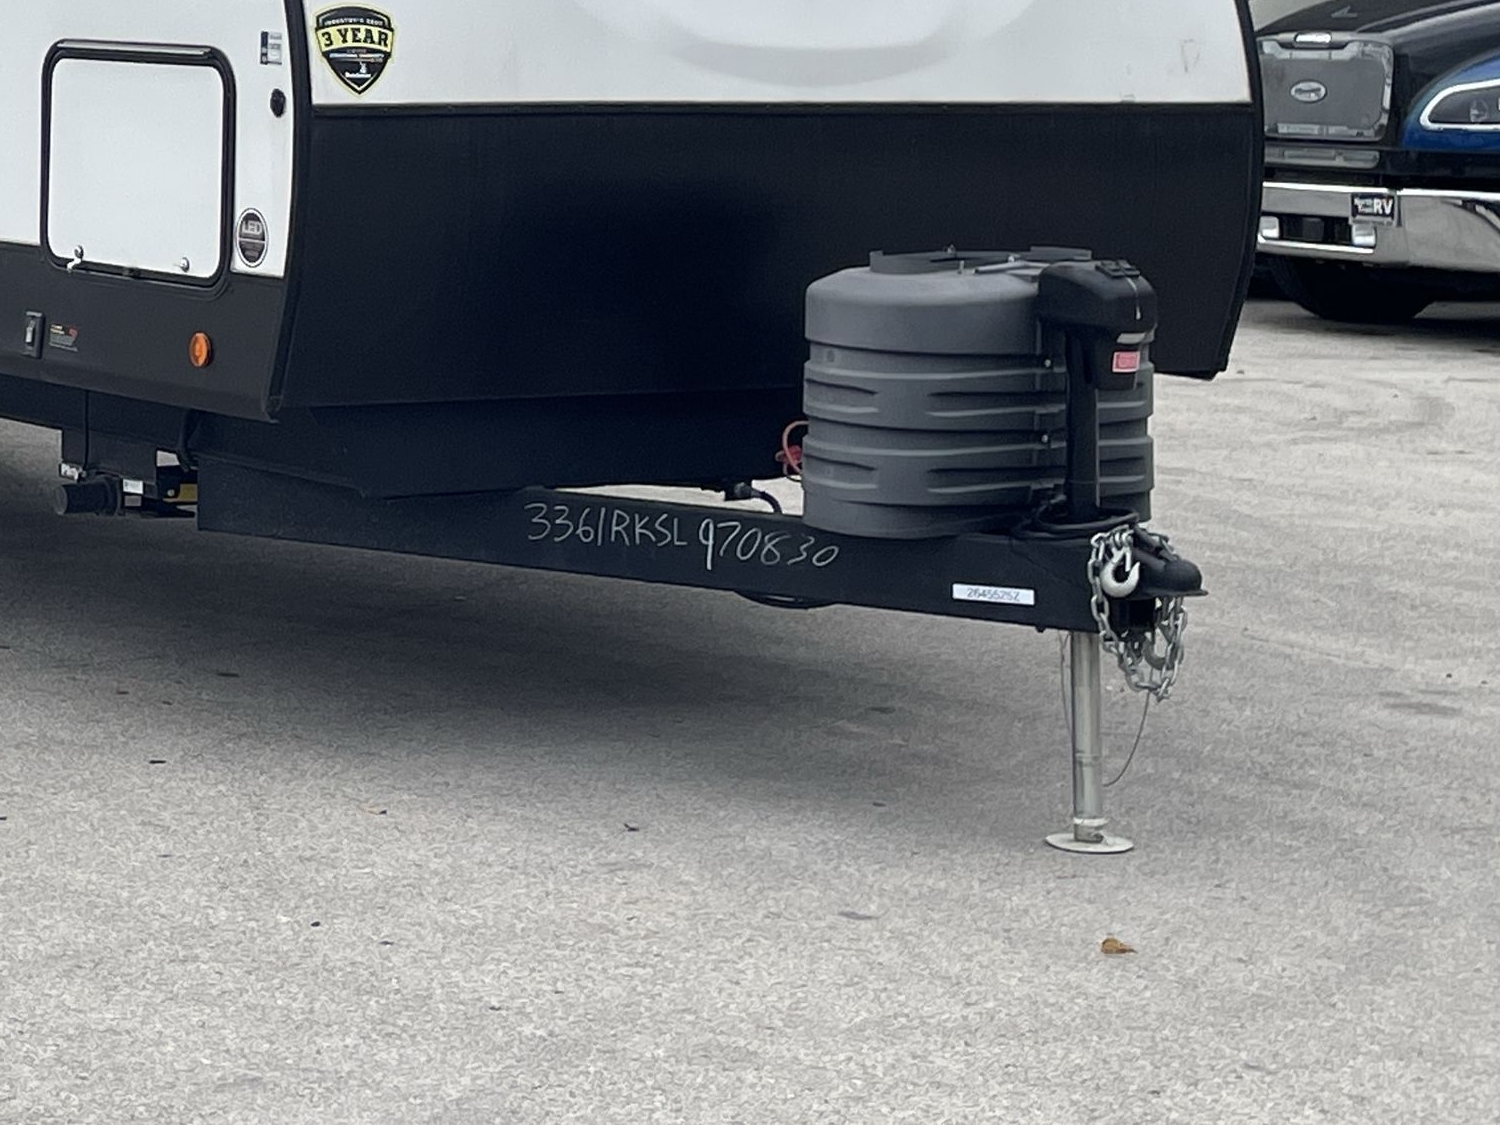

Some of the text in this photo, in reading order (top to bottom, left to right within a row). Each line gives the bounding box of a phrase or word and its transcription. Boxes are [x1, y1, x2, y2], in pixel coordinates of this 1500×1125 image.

[321, 27, 389, 48] 3 YEAR
[698, 518, 840, 571] 970830
